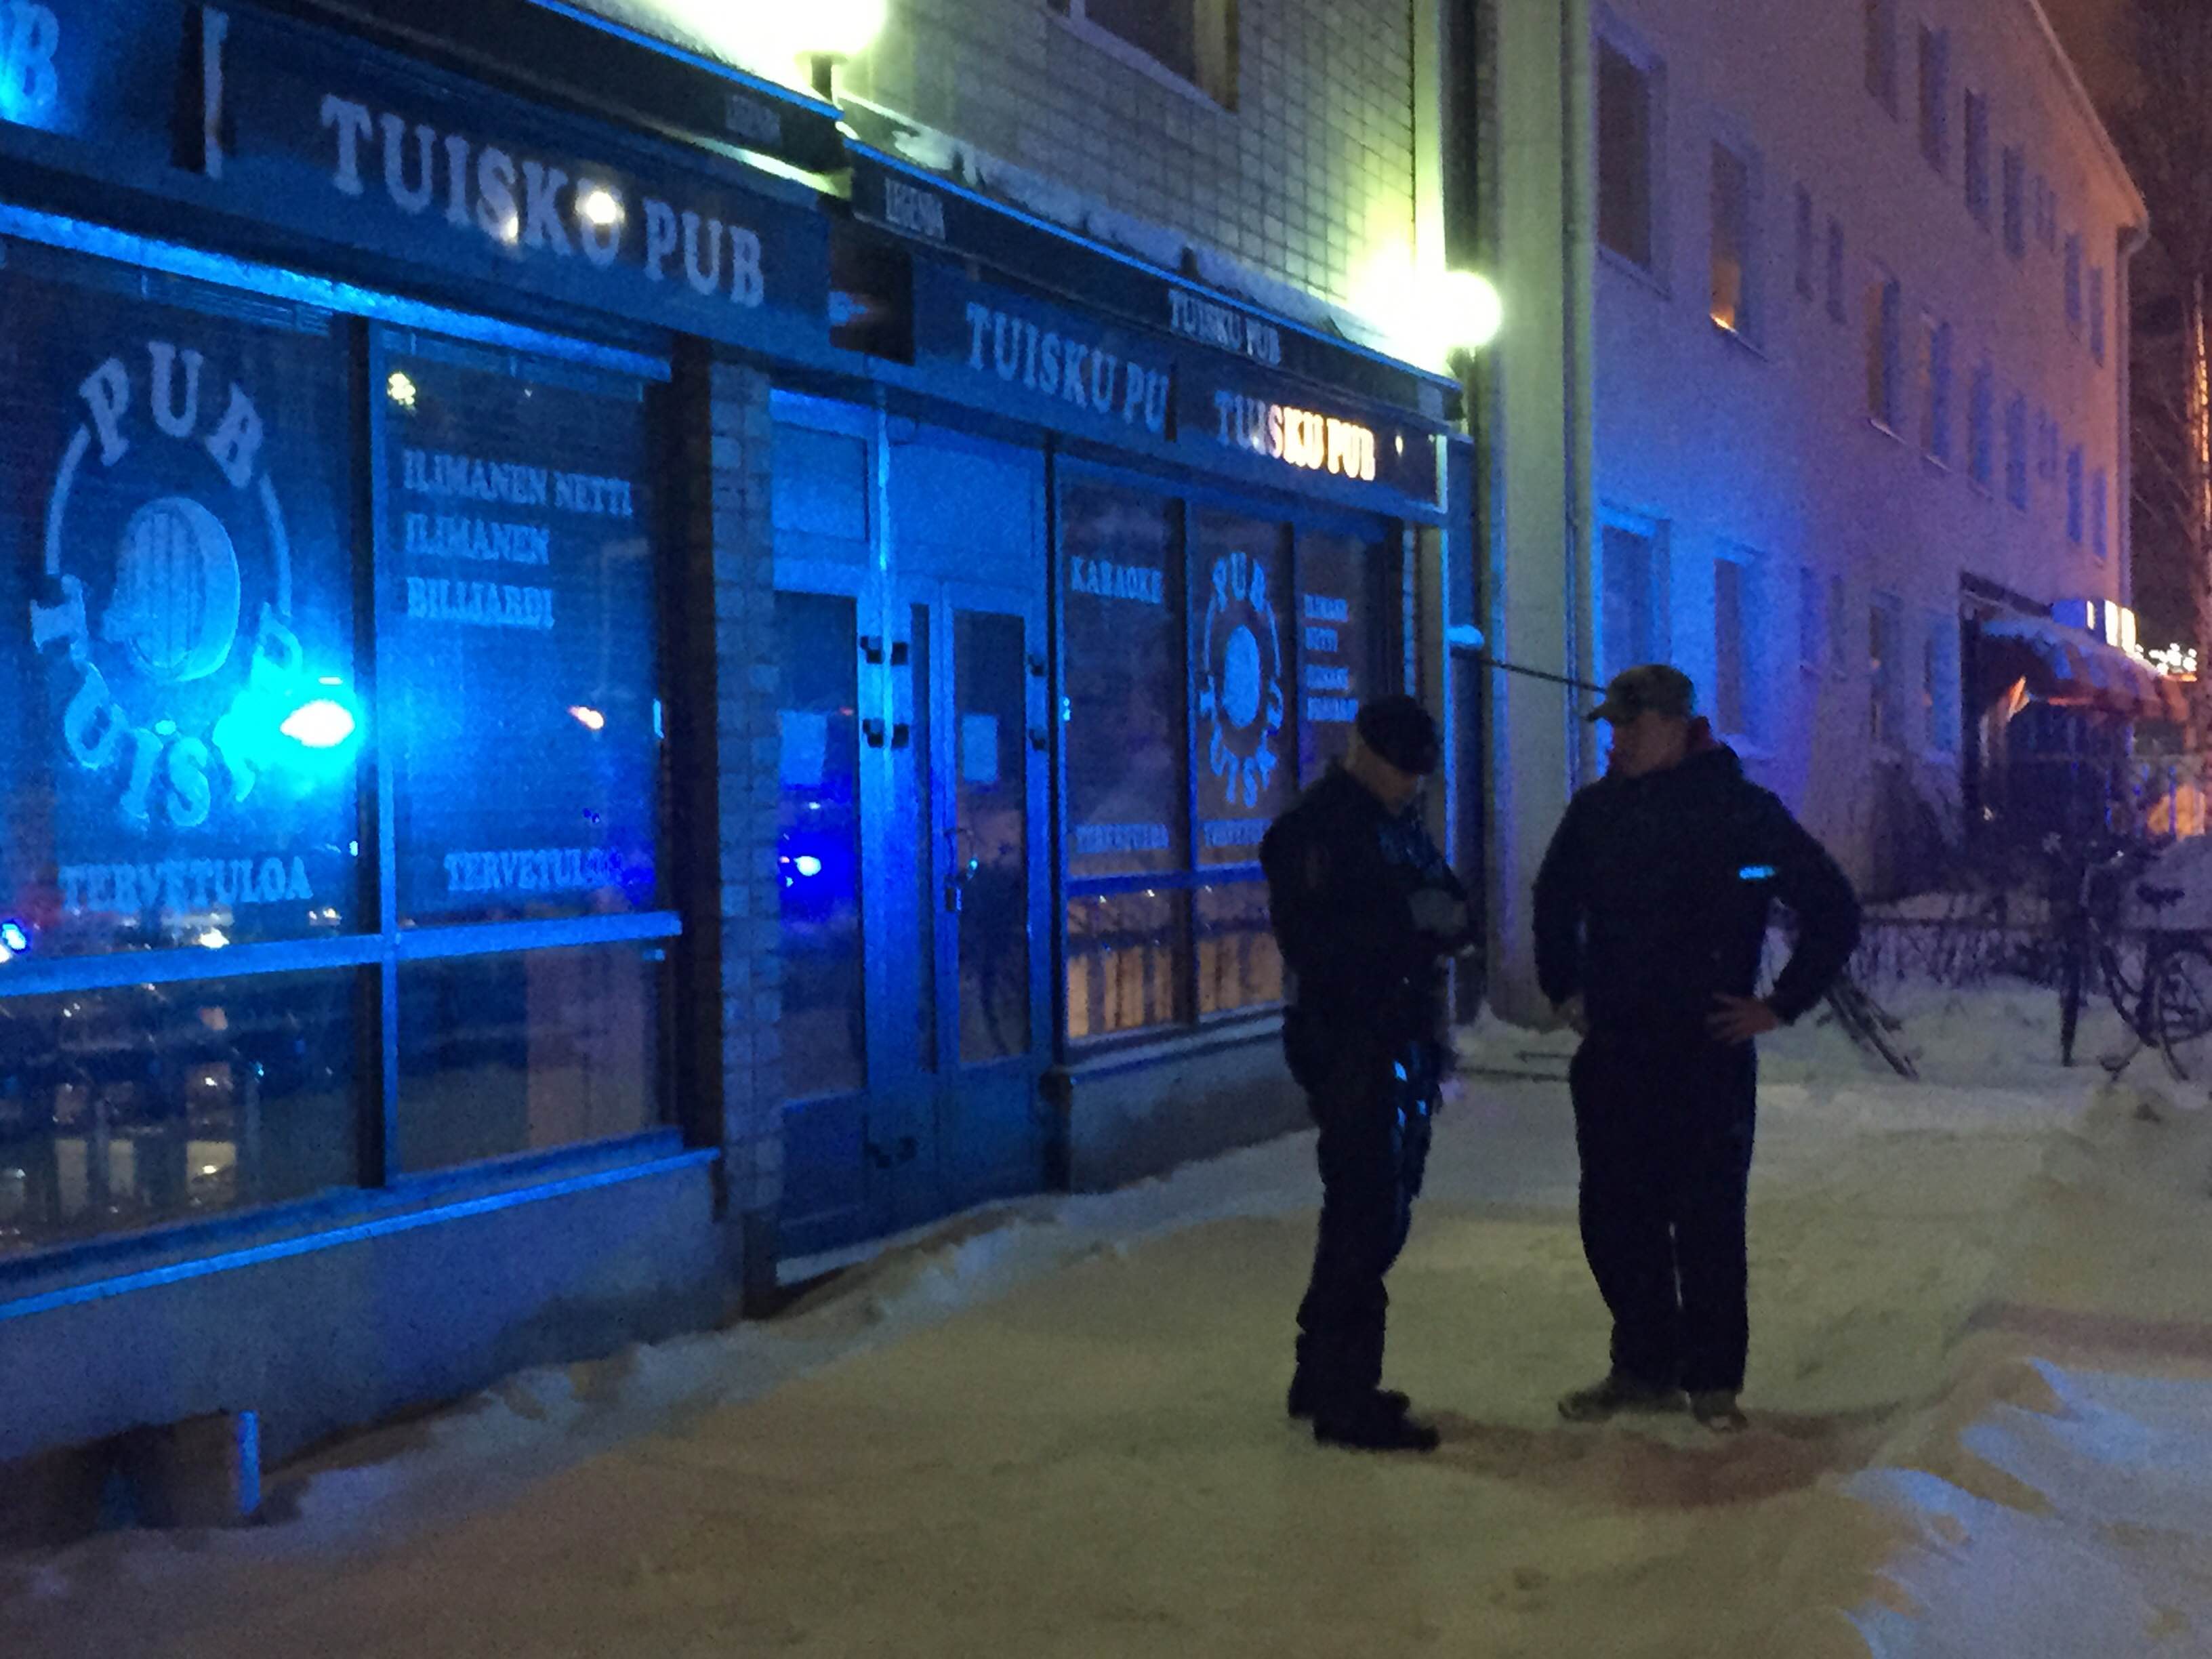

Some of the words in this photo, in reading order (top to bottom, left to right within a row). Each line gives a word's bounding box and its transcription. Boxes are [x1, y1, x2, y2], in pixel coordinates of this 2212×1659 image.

[321, 93, 623, 266] TUISKU
[643, 197, 764, 308] PUB
[966, 301, 1118, 414] TUISKU
[1168, 289, 1243, 350] TUISKU
[1244, 316, 1281, 365] PUB
[80, 340, 263, 489] PUB
[1213, 391, 1324, 470] TUISKU
[1326, 416, 1376, 481] PUB
[1212, 552, 1266, 612] PUB
